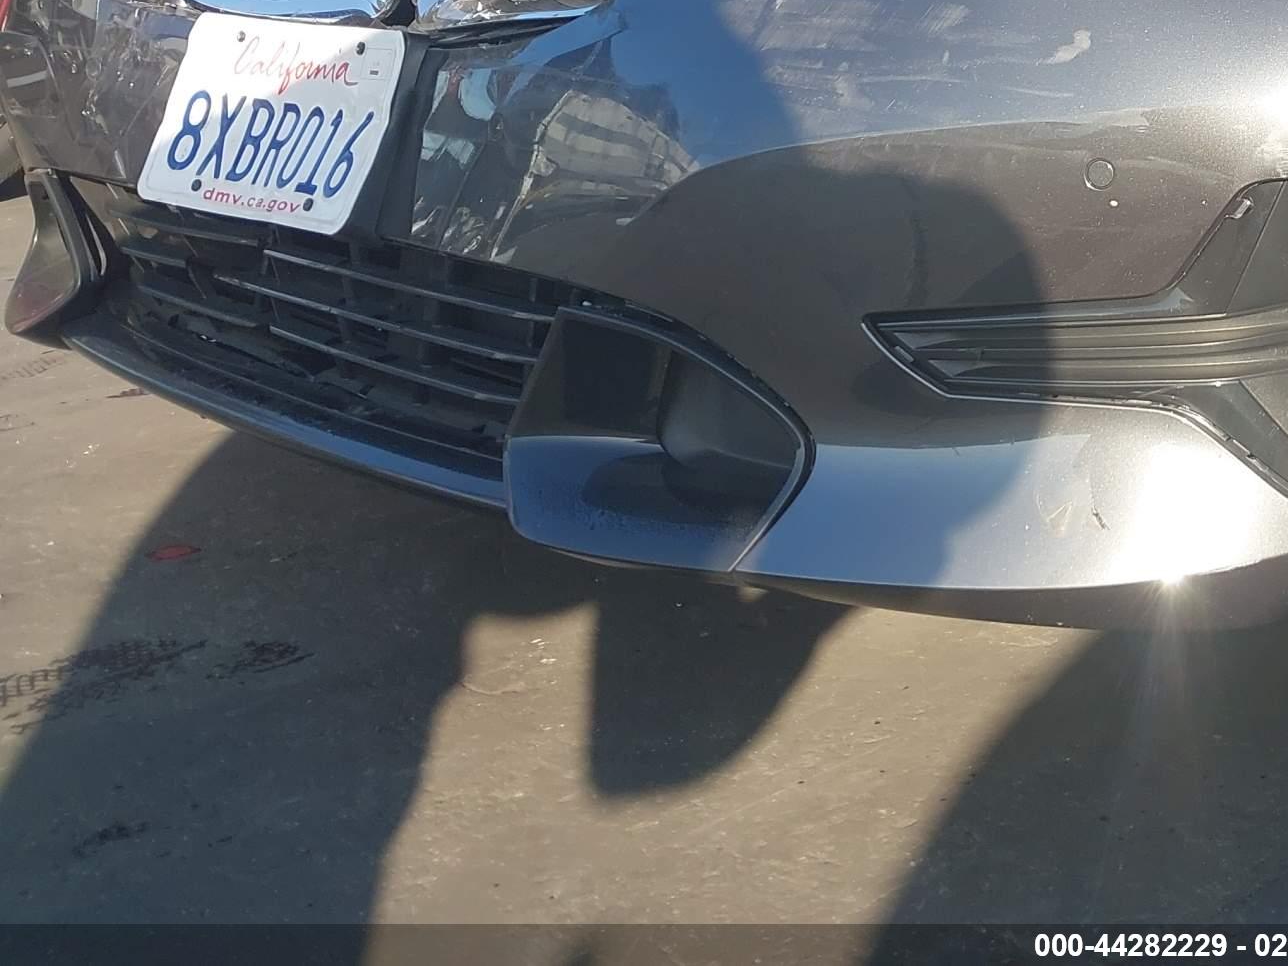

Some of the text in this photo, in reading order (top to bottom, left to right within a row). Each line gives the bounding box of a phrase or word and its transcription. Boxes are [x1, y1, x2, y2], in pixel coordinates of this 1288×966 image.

[233, 36, 358, 95] California
[167, 89, 376, 199] 8XBR016
[202, 188, 302, 215] dmv.ca.gov
